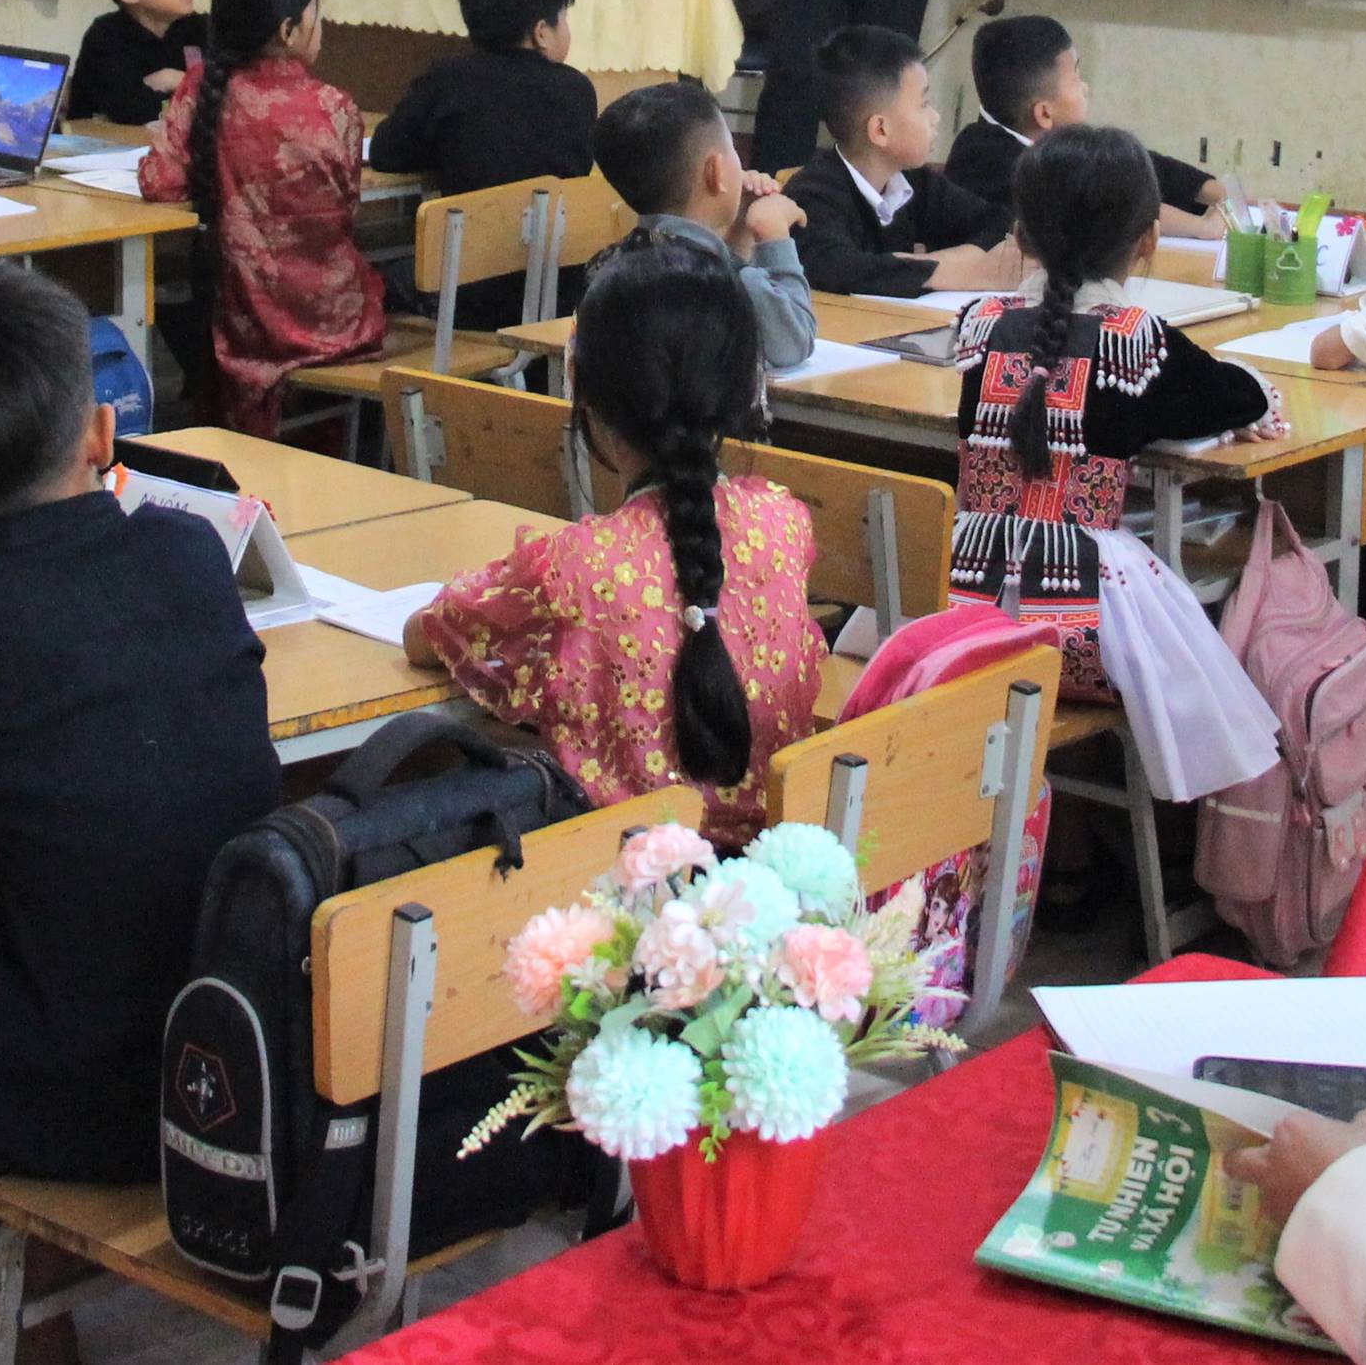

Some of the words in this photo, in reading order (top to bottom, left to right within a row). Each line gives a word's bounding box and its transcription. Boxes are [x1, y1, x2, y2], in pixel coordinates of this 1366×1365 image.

[1146, 1105, 1193, 1134] 3
[1156, 1143, 1197, 1206] HỘI
[1137, 1204, 1176, 1235] XÃ
